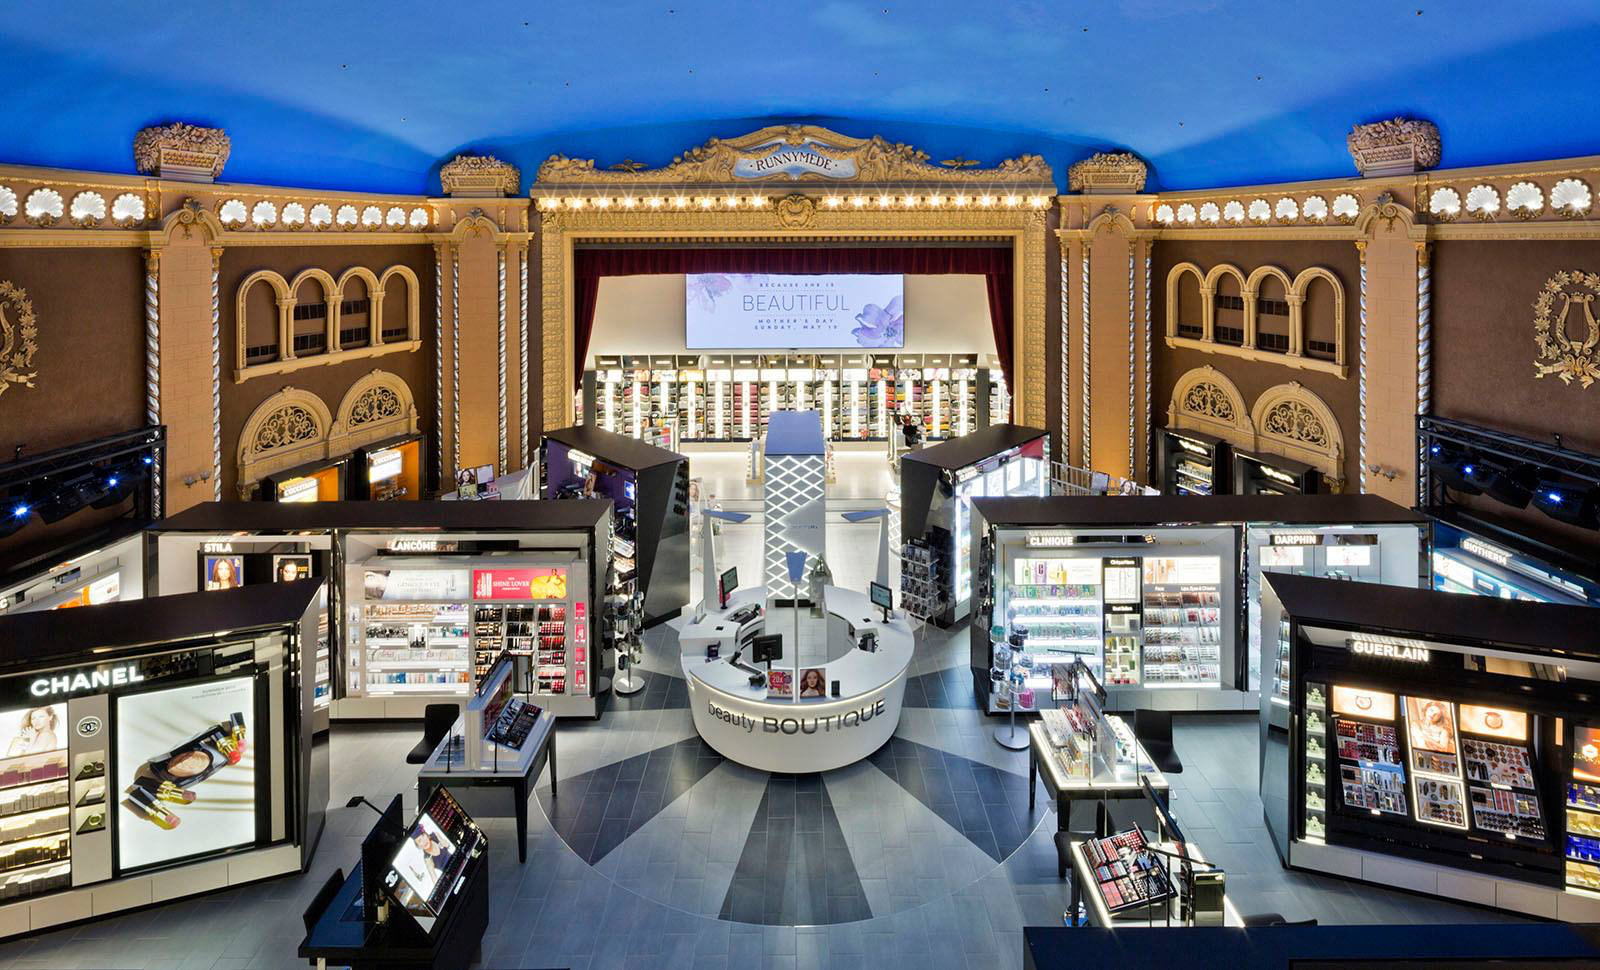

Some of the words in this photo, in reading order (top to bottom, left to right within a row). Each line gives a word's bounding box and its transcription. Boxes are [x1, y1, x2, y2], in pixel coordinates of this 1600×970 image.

[755, 151, 832, 171] RUNNYMEDE
[743, 295, 849, 311] BEAUTIFUL
[204, 542, 233, 553] STILA
[391, 540, 438, 551] LANCÔME
[1029, 536, 1074, 546] CLINIQUE
[1274, 535, 1317, 545] DARPHIN
[1463, 540, 1508, 566] BIOTHERM
[1353, 641, 1429, 661] GUERLAIN
[31, 666, 144, 696] CHANEL
[708, 700, 755, 733] beauty
[763, 698, 886, 734] BOUTIQUE
